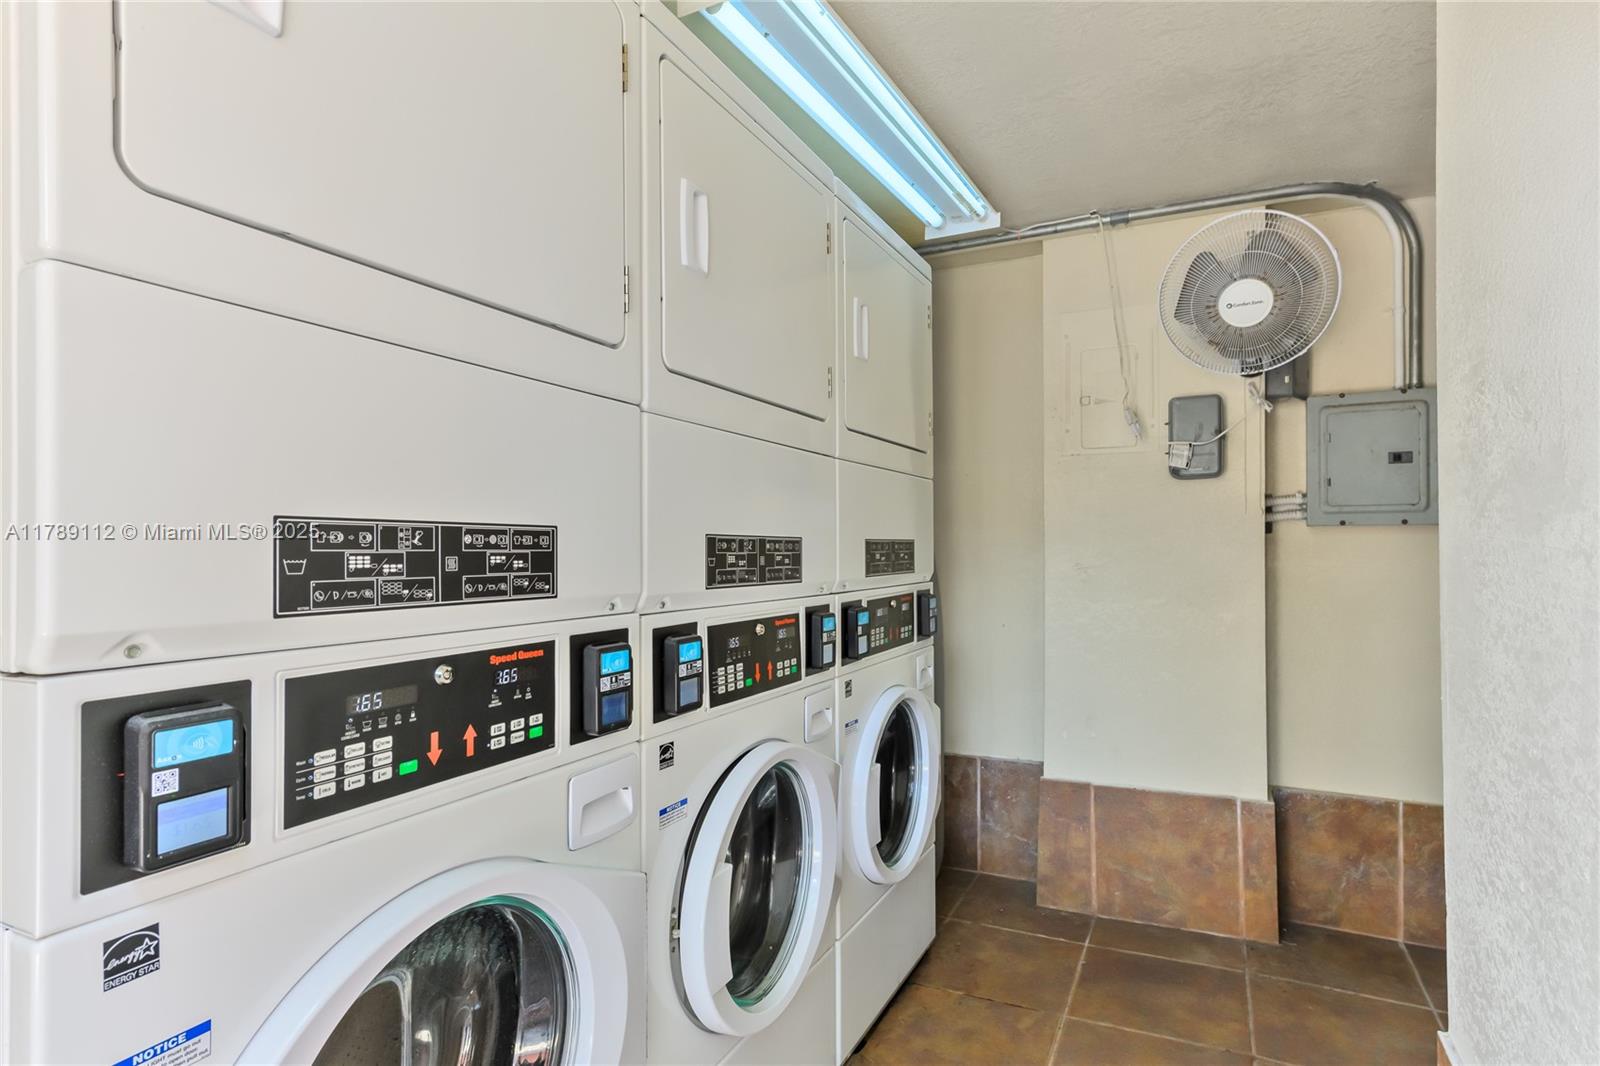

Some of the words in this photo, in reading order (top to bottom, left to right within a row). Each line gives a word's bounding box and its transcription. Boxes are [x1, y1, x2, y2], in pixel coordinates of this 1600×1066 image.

[489, 651, 517, 666] Speed
[518, 648, 544, 660] Queen
[104, 970, 137, 990] ENERGY
[138, 961, 160, 977] STAR
[132, 1032, 187, 1066] NOTICE
